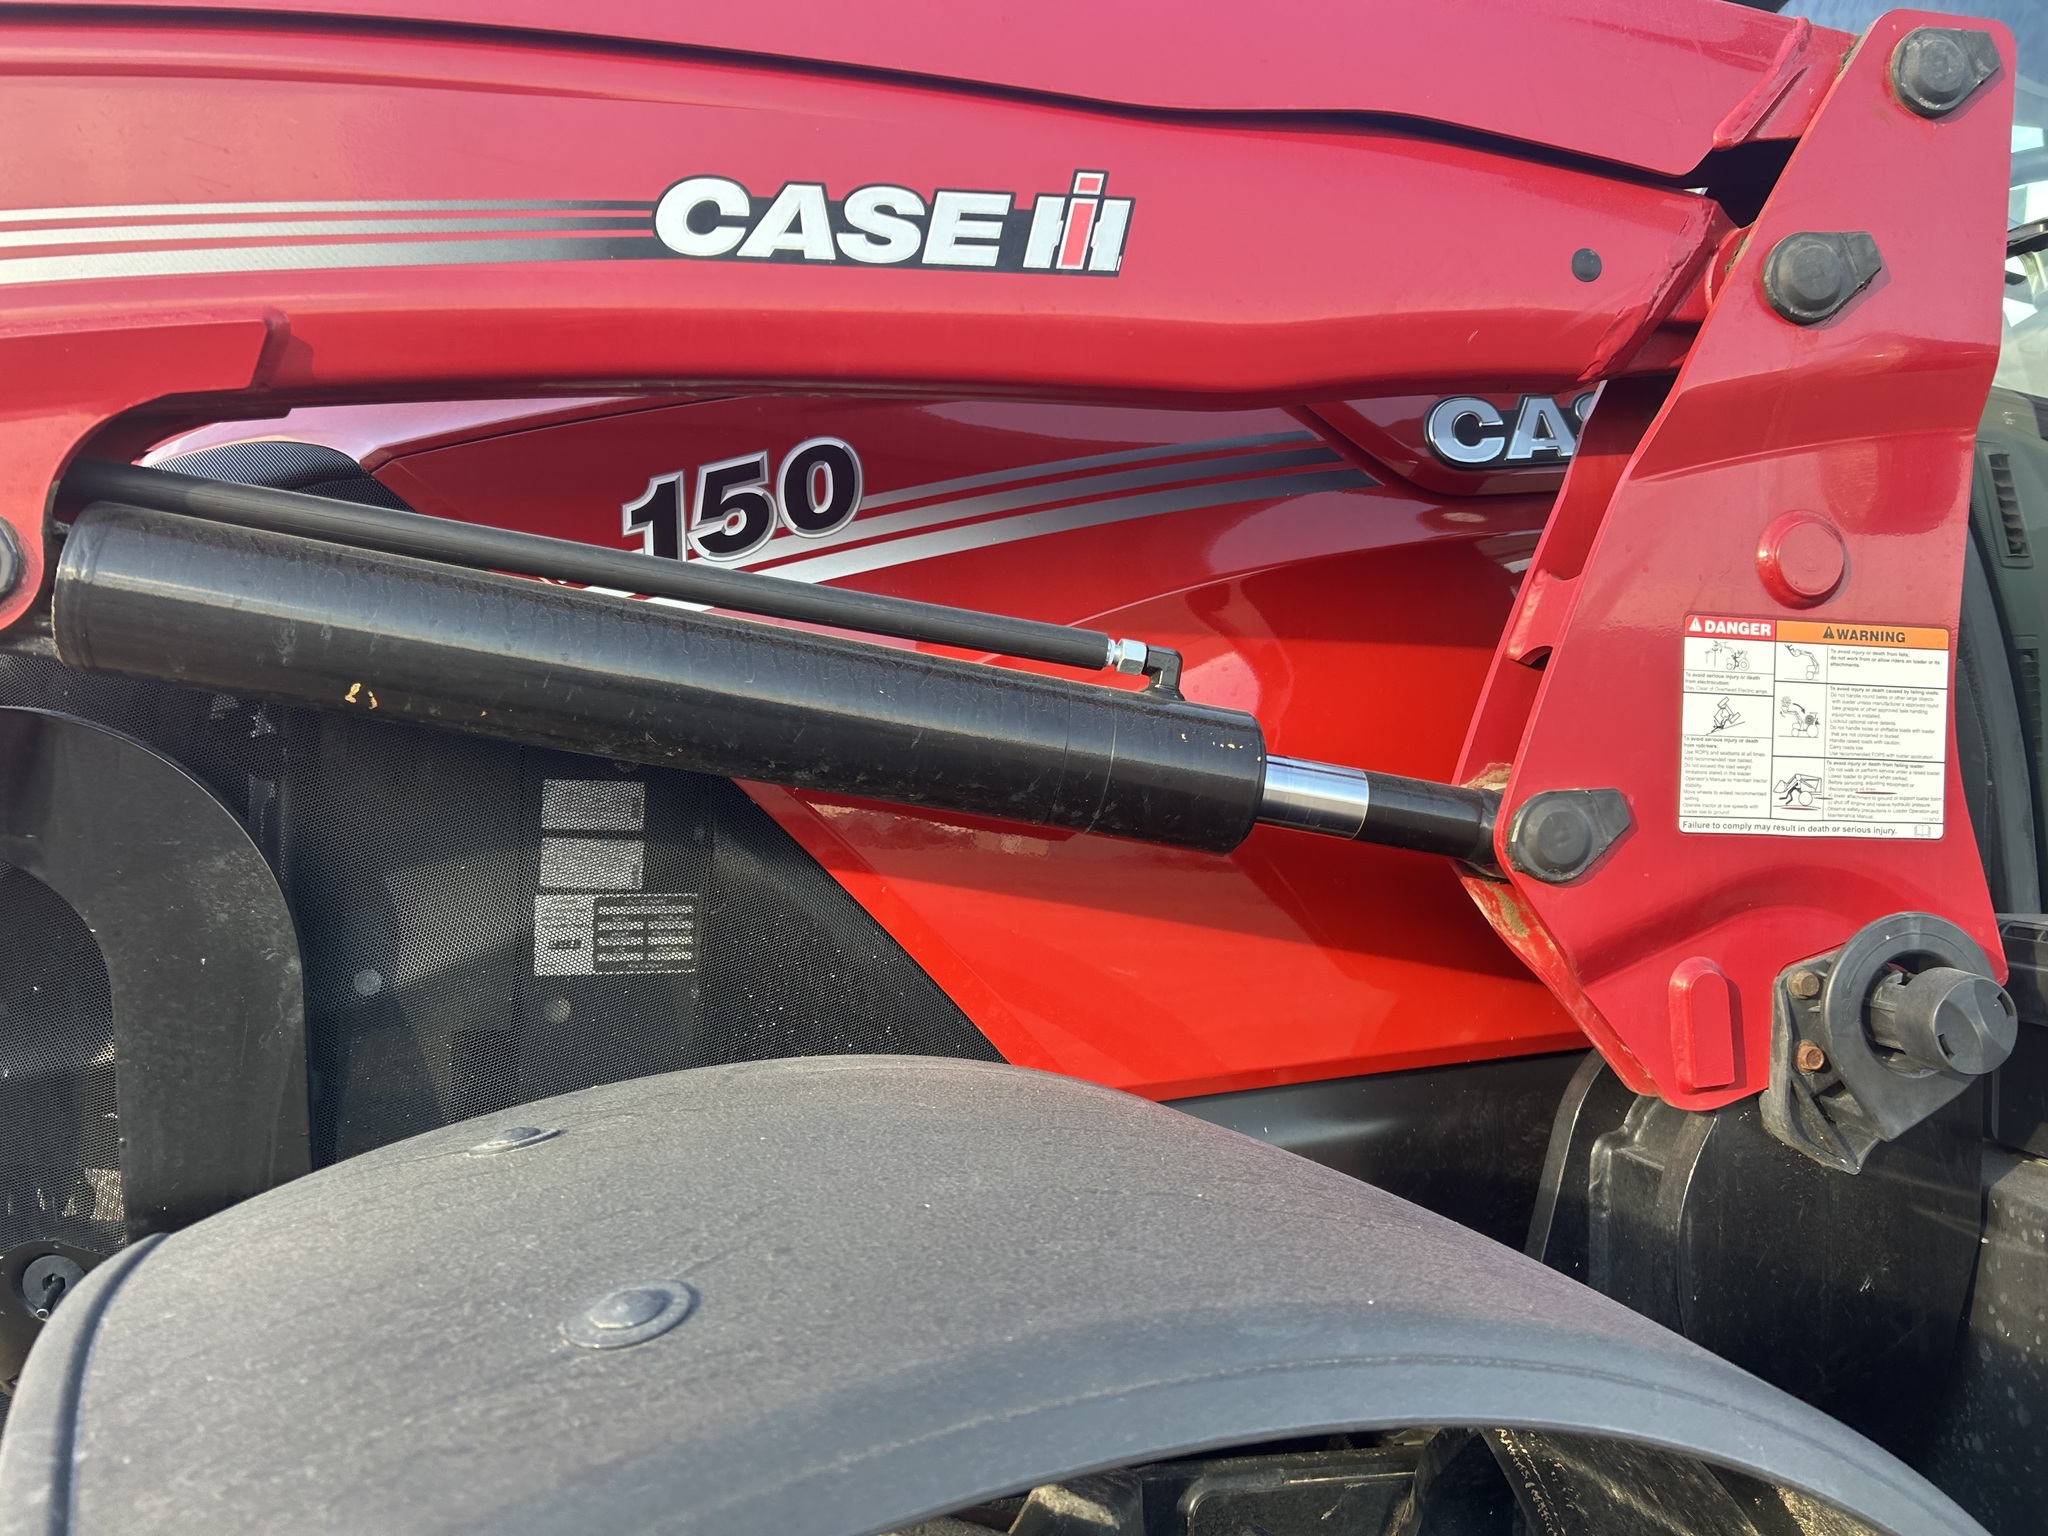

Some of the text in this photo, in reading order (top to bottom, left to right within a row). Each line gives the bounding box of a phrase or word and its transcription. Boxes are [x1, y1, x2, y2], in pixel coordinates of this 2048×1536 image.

[654, 175, 1013, 267] CASE
[622, 437, 864, 562] 150
[1704, 620, 1772, 636] DANGER
[1836, 628, 1906, 643] WARNING
[1683, 821, 1710, 829] Failure
[1722, 823, 1752, 832] comply
[1754, 824, 1772, 832] may
[1798, 824, 1805, 832] in
[1873, 827, 1897, 836] injury.
